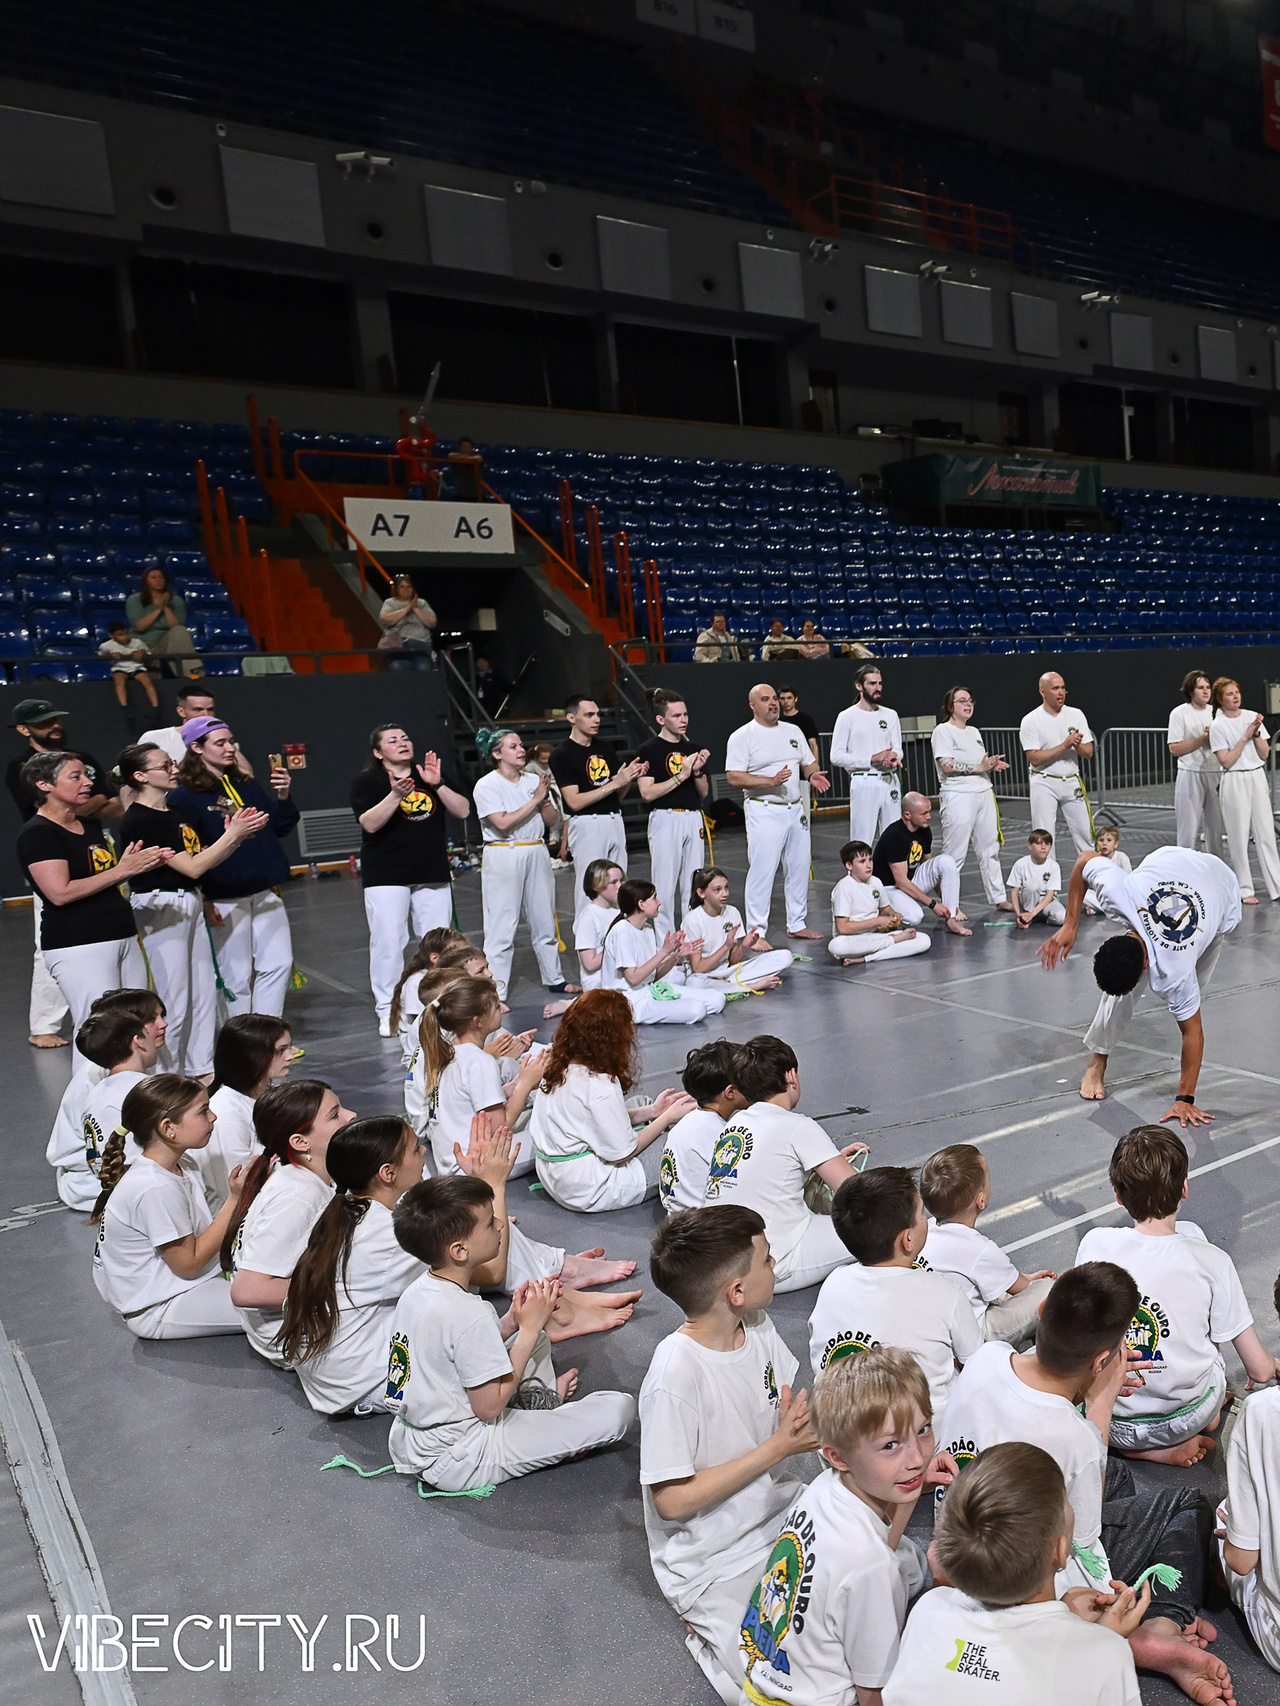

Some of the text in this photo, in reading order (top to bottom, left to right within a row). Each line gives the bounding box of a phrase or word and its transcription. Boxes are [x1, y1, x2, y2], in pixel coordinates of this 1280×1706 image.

[370, 513, 410, 538] A7
[454, 516, 493, 541] A6
[1143, 913, 1159, 942] FLOREAR
[1160, 941, 1170, 949] DE
[91, 1117, 104, 1142] OURO
[737, 1126, 748, 1136] DE
[742, 1133, 754, 1160] OURO
[918, 1256, 929, 1269] DE
[1150, 1302, 1170, 1338] OURO
[820, 1330, 872, 1370] CORDÃO DE
[801, 1519, 816, 1551] DE
[792, 1552, 816, 1635] OURO
[961, 1652, 989, 1669] REAL
[965, 1641, 987, 1657] THE
